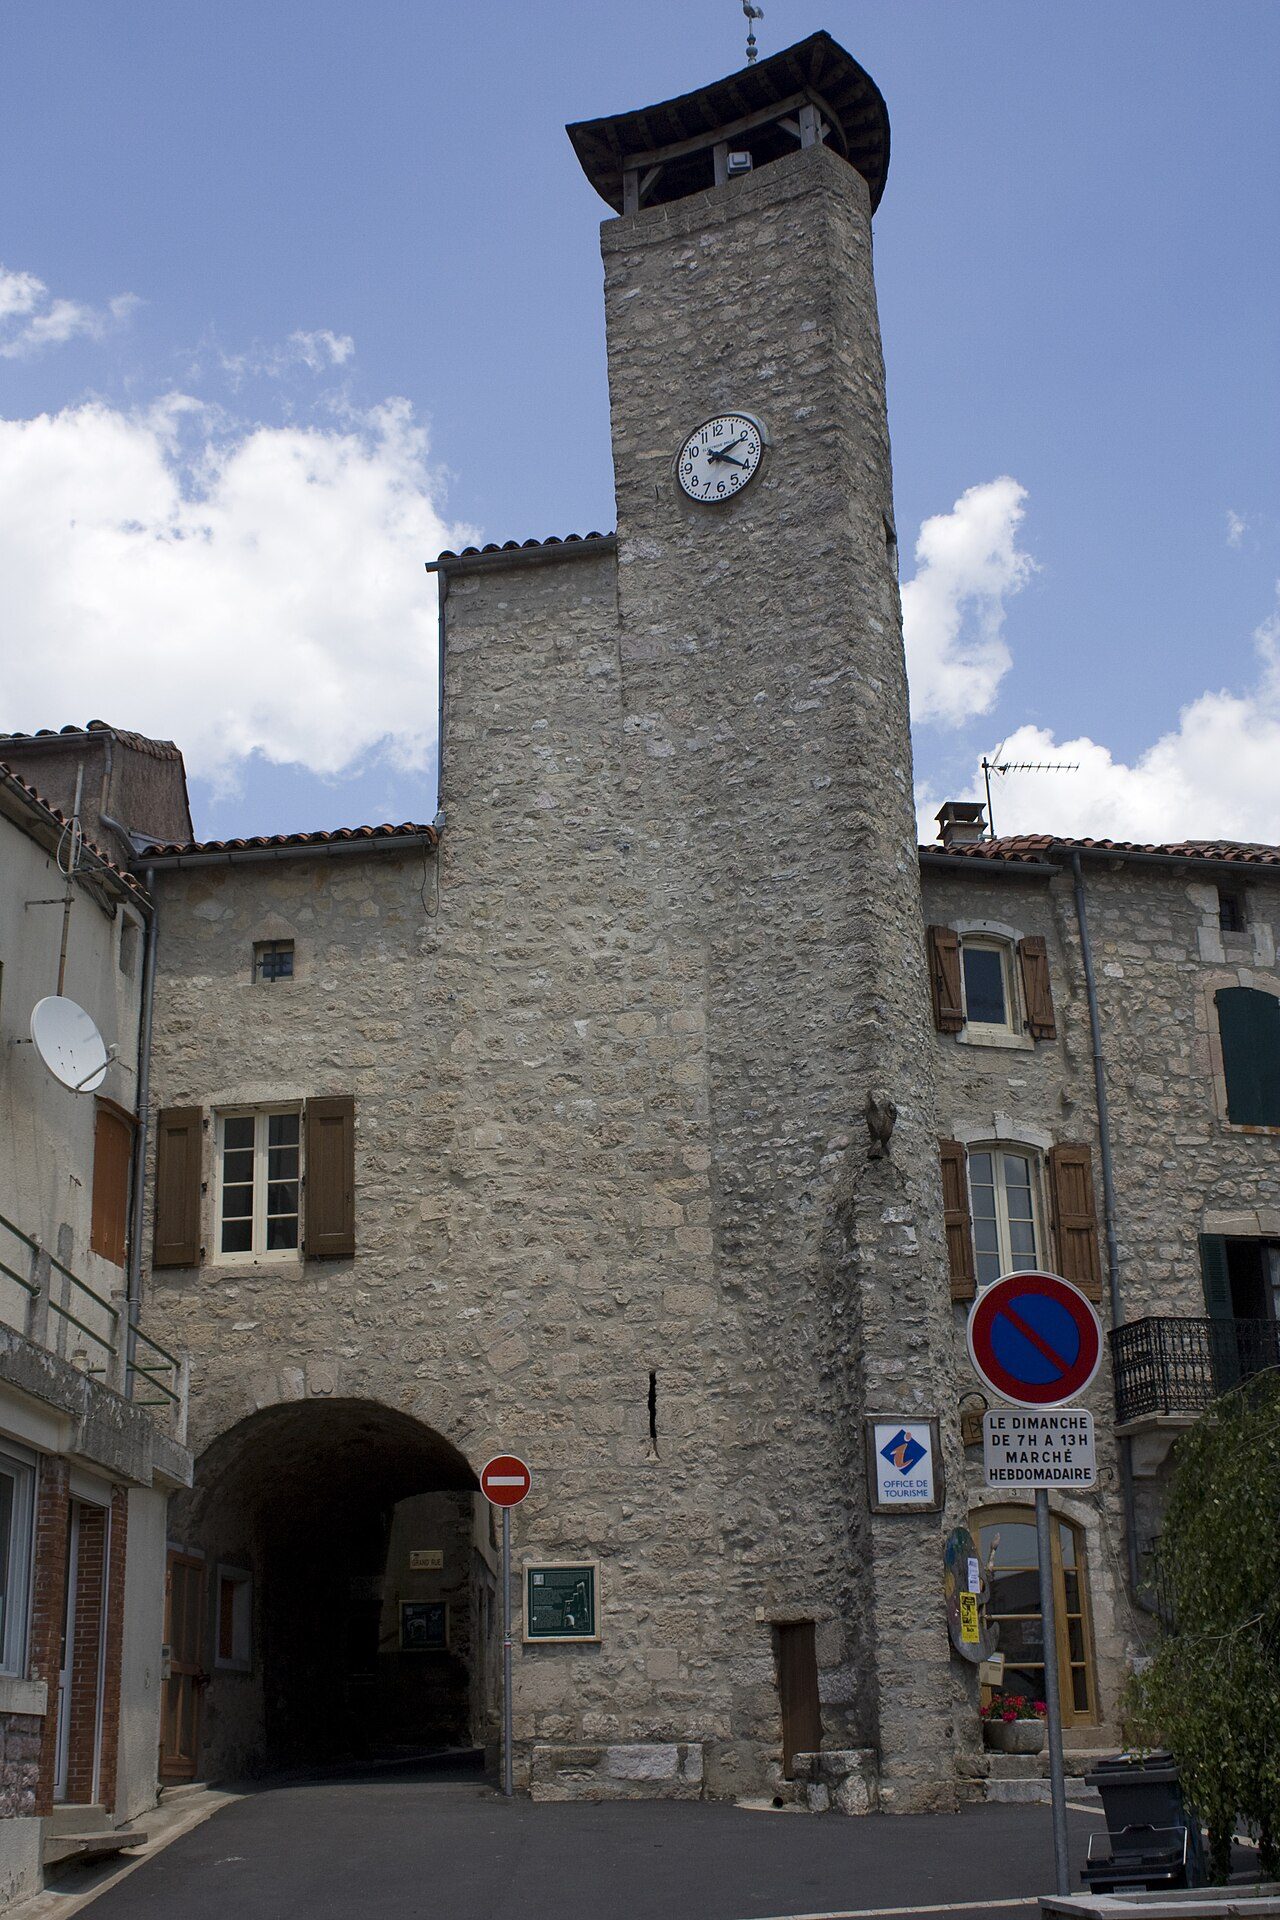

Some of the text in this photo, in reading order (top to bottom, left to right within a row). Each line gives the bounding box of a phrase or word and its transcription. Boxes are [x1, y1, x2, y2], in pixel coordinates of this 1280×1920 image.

[712, 424, 723, 437] 12
[730, 423, 734, 434] 1
[701, 431, 708, 444] 11
[740, 430, 749, 442] 2
[688, 446, 699, 460] 10
[747, 442, 756, 455] 3
[684, 462, 692, 474] 9
[741, 458, 751, 470] 4
[691, 475, 699, 487] 8
[730, 473, 739, 486] 5
[703, 482, 711, 495] 7
[716, 481, 726, 492] 6
[990, 1417, 1088, 1429] LE DIMANCHE
[992, 1434, 1088, 1446] DE 7H A 13H
[1006, 1449, 1072, 1463] MARCHÉ
[989, 1468, 1092, 1480] HEBDOMADAIRE
[883, 1479, 928, 1488] OFFICE DE
[884, 1489, 928, 1497] TOURISME
